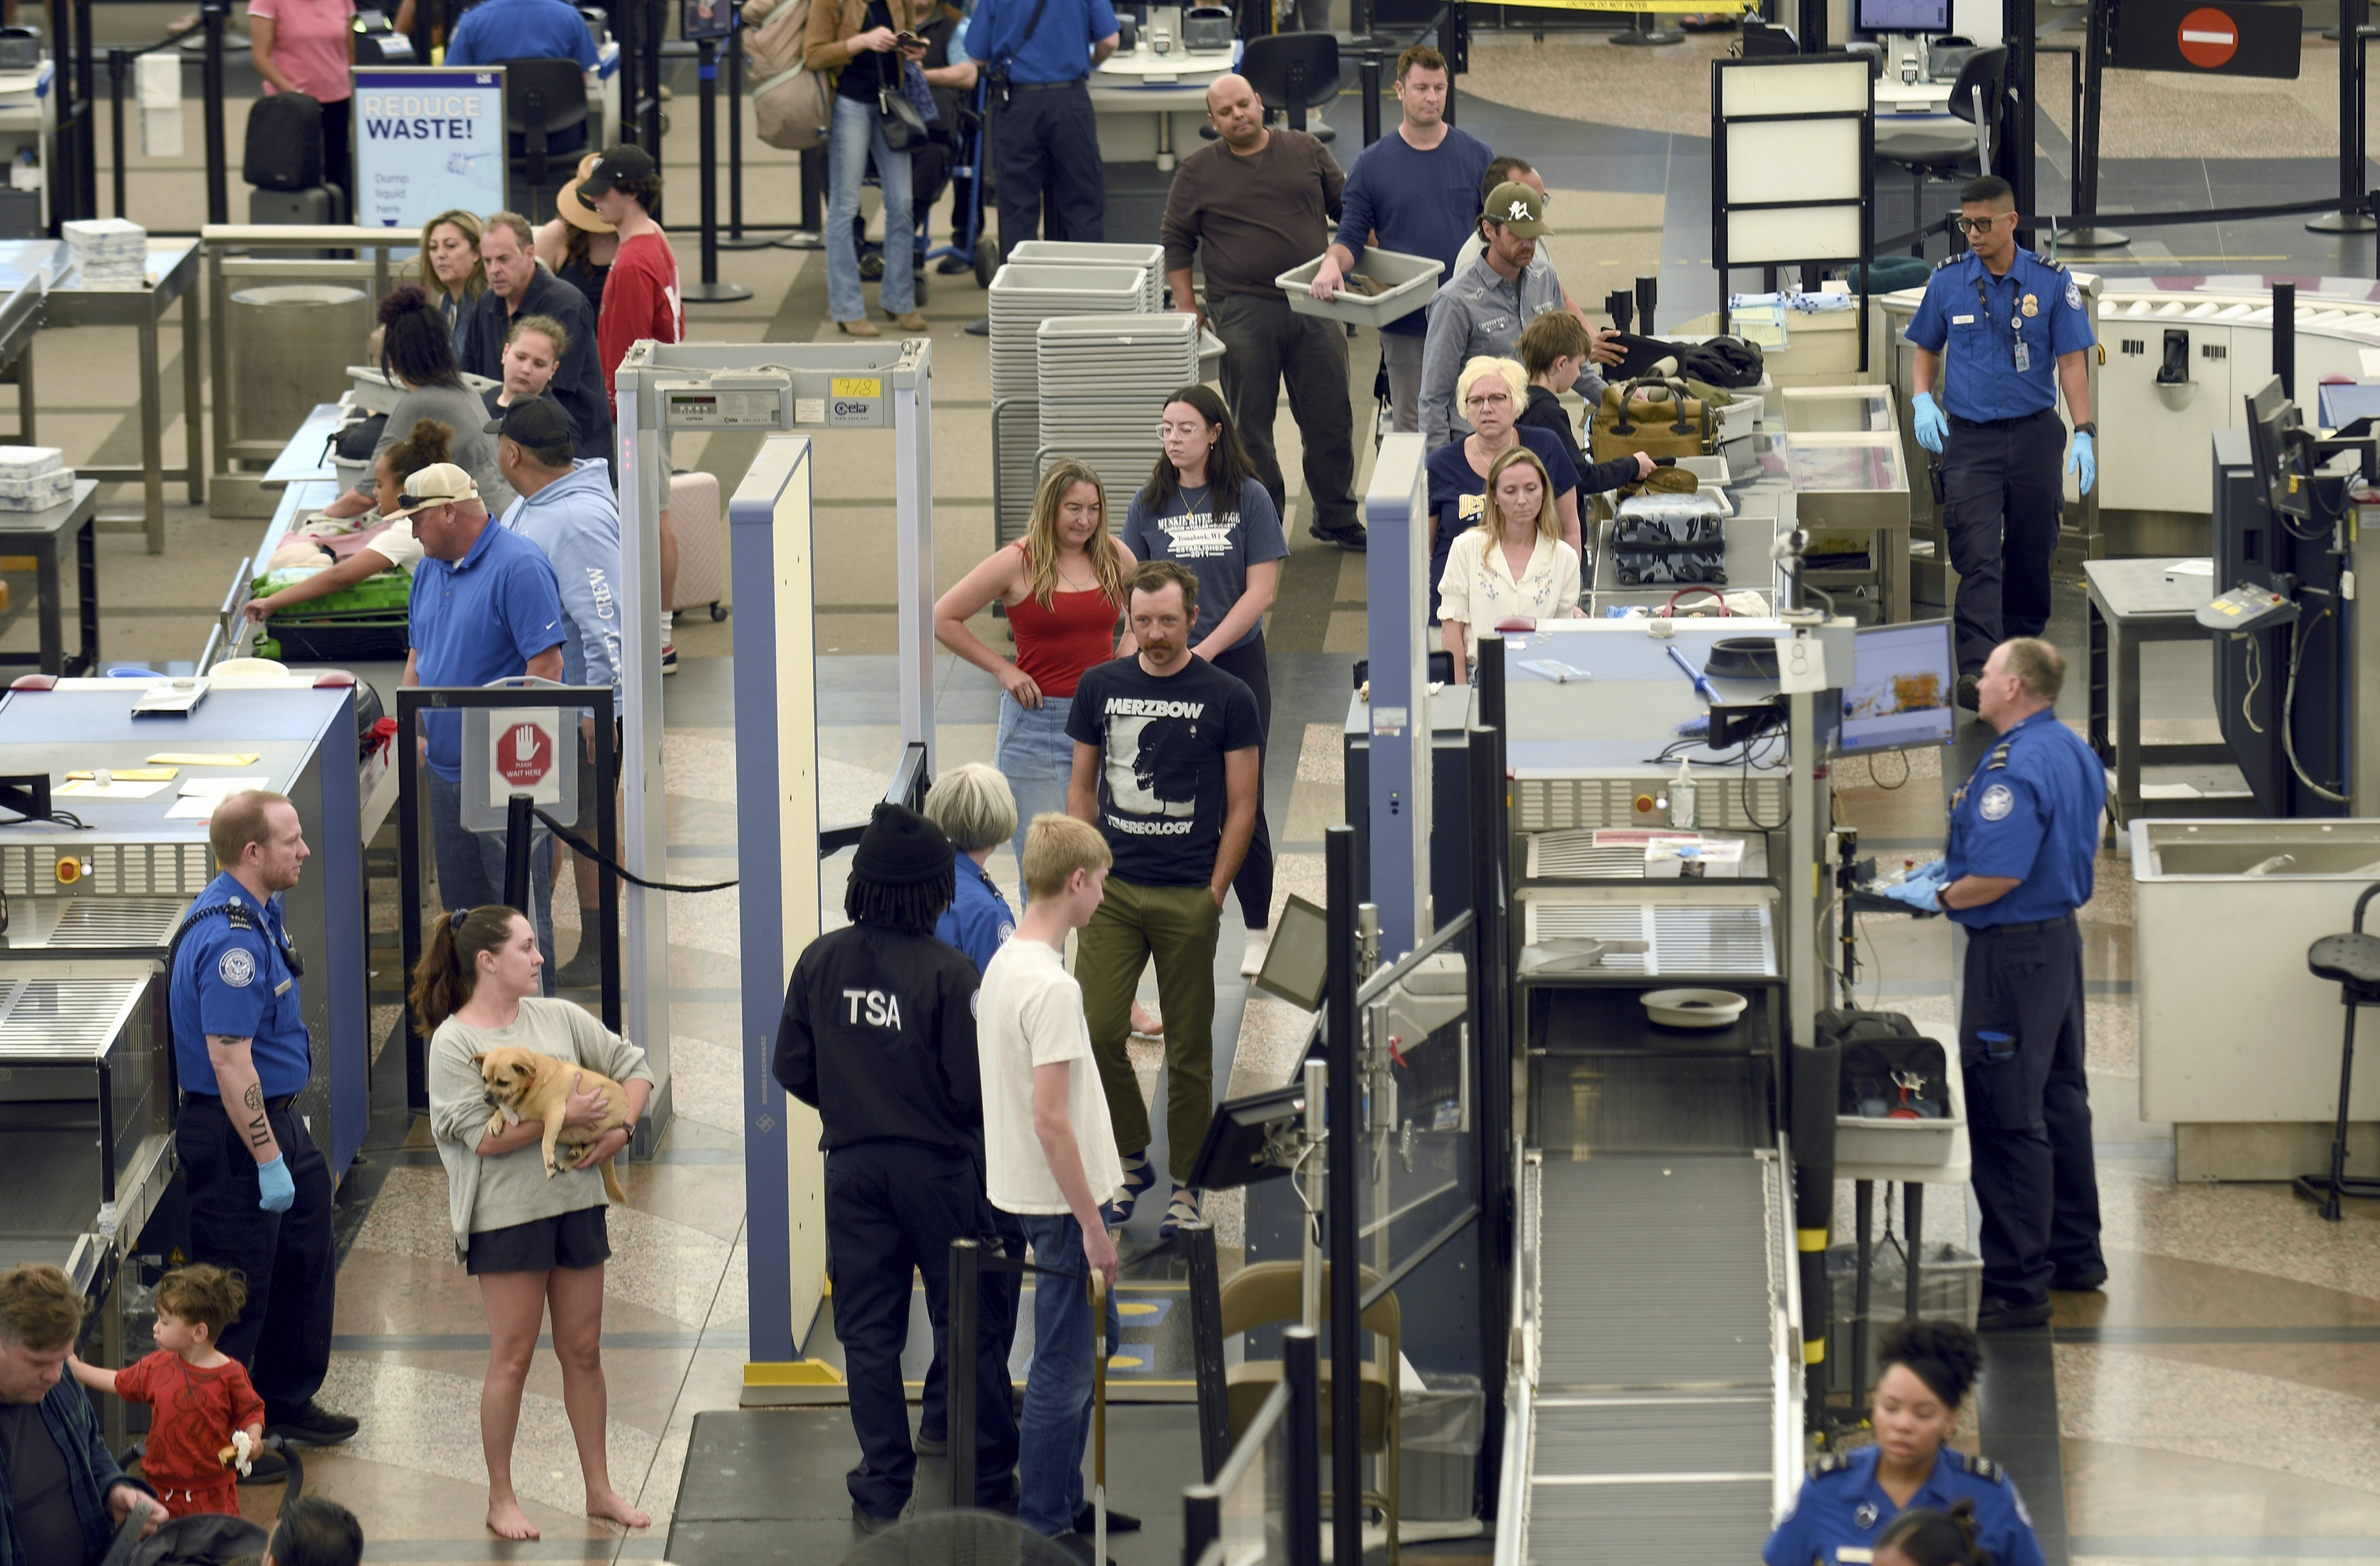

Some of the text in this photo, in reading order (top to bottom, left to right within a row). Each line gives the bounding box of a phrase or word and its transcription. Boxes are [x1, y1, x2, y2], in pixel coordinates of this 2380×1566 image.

[1625, 2, 1648, 10] ENTER
[364, 95, 481, 117] REDUCE
[367, 119, 473, 139] WASTE!
[375, 174, 409, 185] Dump
[376, 189, 406, 199] liquid
[376, 205, 401, 213] here
[839, 378, 872, 396] 7/8
[1157, 515, 1188, 531] MUSKIE
[1189, 512, 1213, 525] RIVER
[585, 566, 621, 686] SALTY CREW
[1788, 643, 1809, 676] 8
[1104, 697, 1205, 720] MERZBOW
[506, 770, 524, 778] WAIT
[1104, 813, 1194, 835] VENEREOLOGY
[843, 989, 901, 1031] TSA
